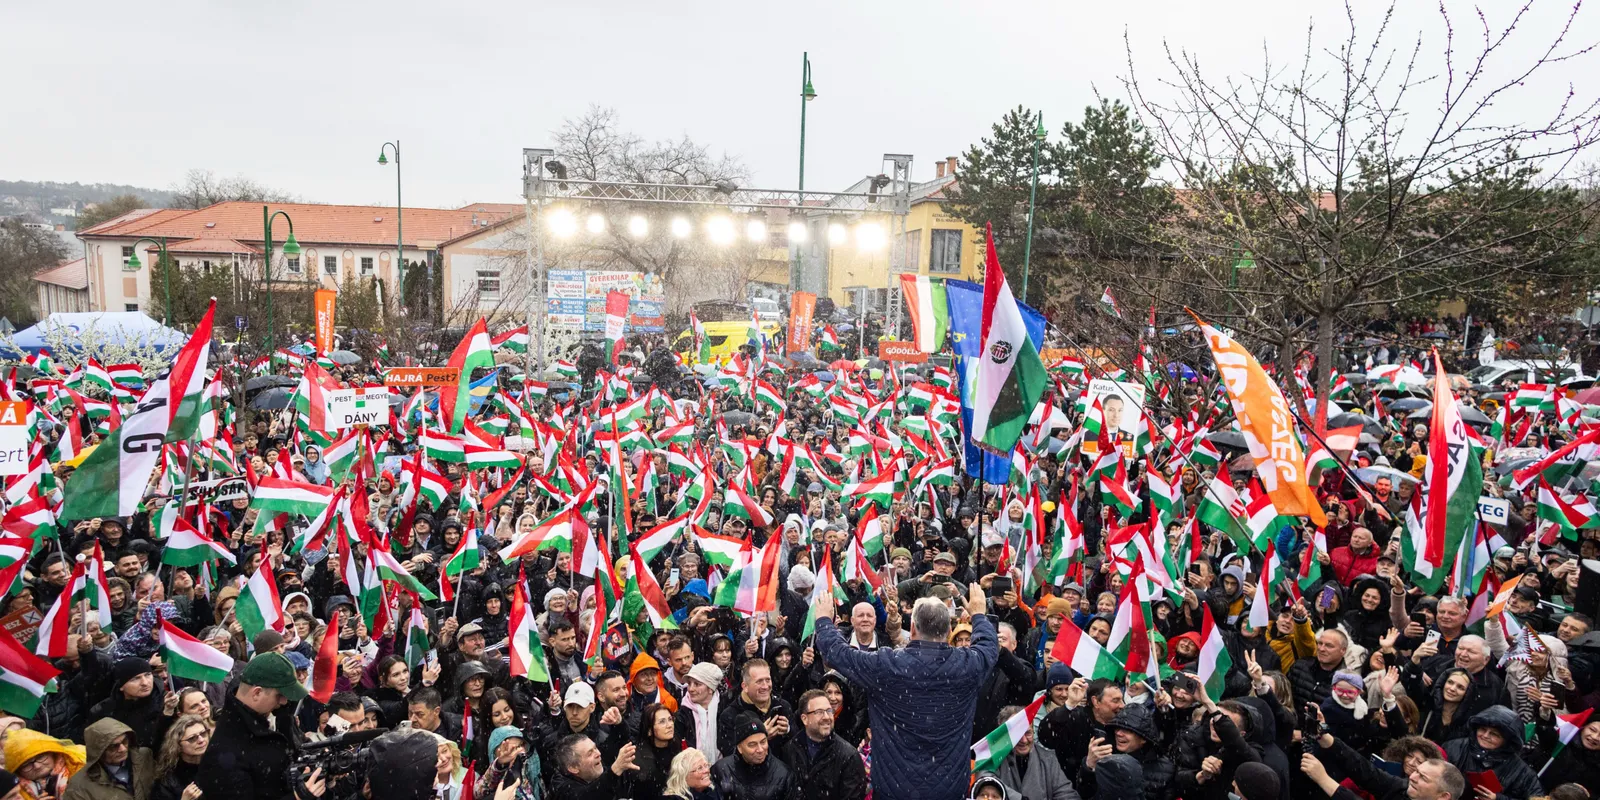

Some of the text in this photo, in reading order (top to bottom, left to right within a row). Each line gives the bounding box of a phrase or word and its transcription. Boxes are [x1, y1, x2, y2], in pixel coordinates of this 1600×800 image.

[589, 273, 629, 283] GYEREKNAP
[793, 315, 803, 345] FIDESZ
[385, 371, 458, 383] HAJRÁ Pest7
[1093, 383, 1114, 392] Katus
[334, 395, 352, 403] PEST
[365, 393, 389, 401] MEGYE
[0, 402, 17, 424] Á
[344, 411, 379, 425] DÁNY
[189, 481, 245, 500] SÜLYSÁP
